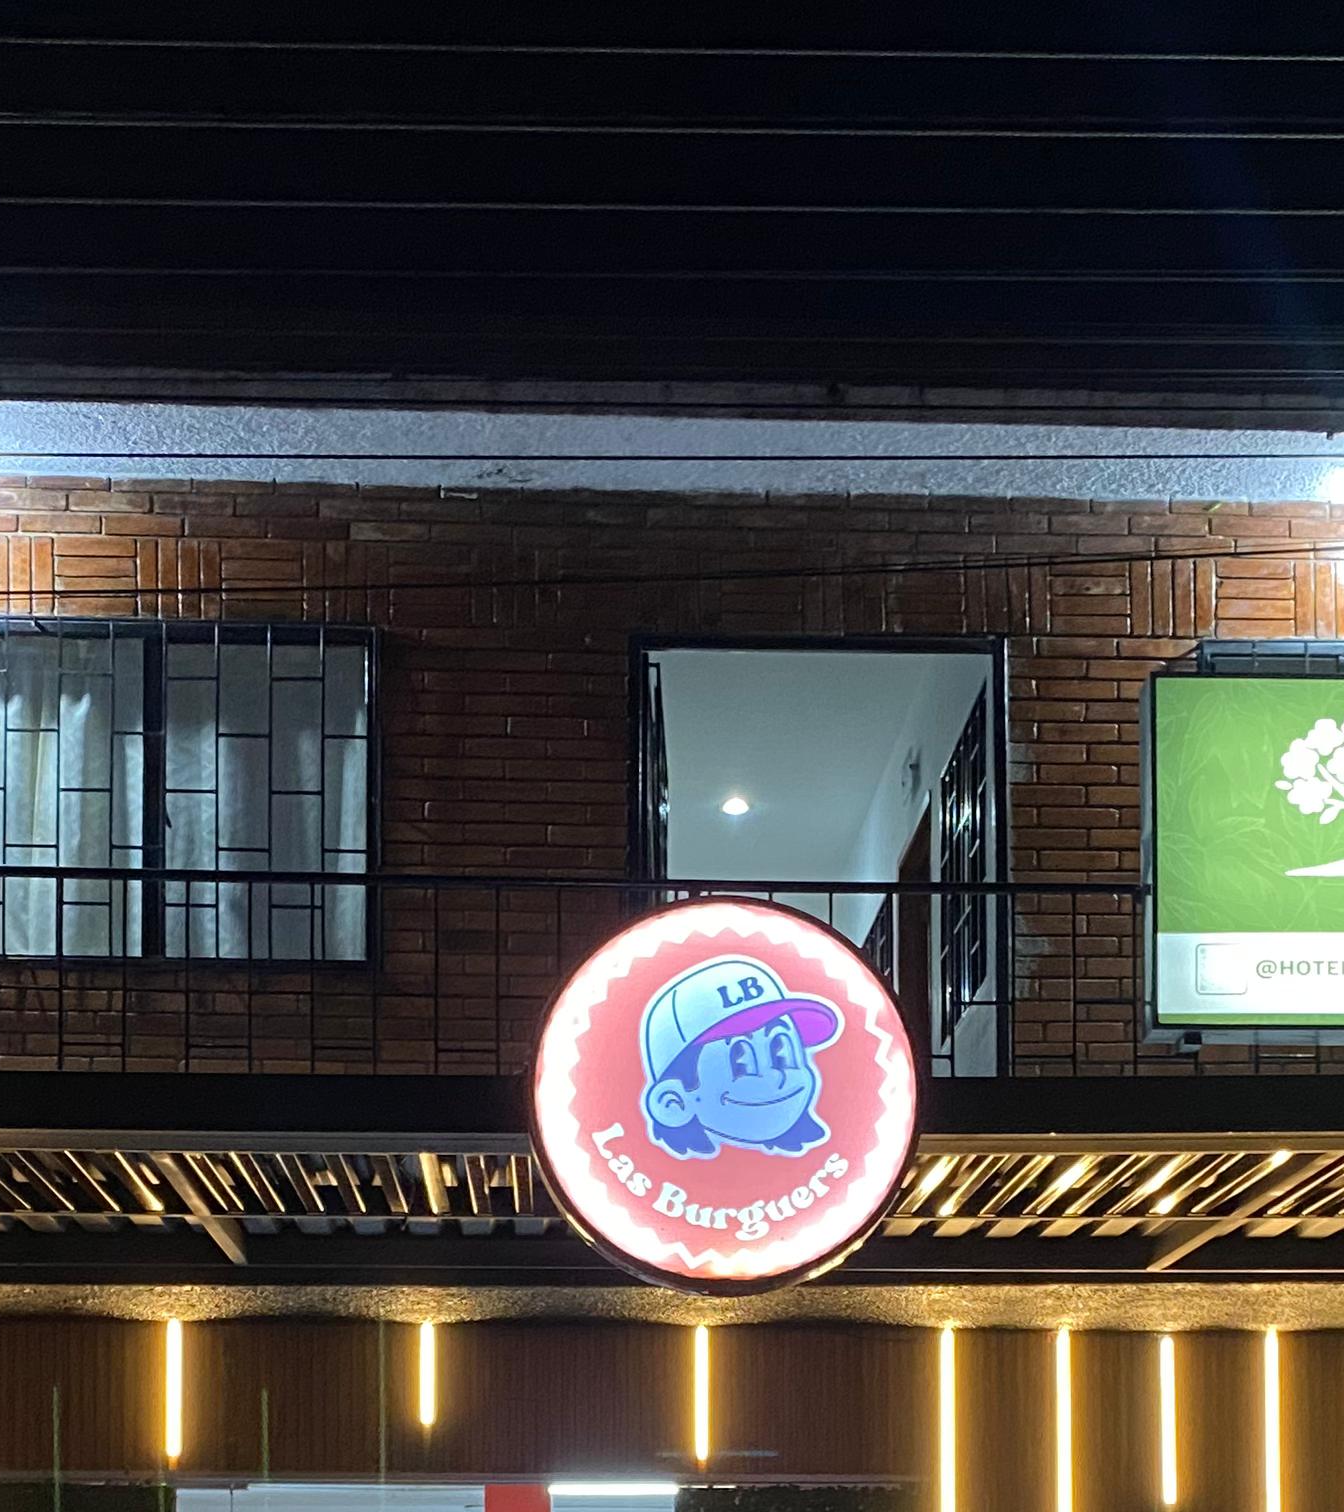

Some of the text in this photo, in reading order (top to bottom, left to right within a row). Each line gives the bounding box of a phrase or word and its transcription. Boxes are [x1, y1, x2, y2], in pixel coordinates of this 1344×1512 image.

[717, 977, 764, 1008] LB
[591, 1122, 849, 1241] Las Burguers
